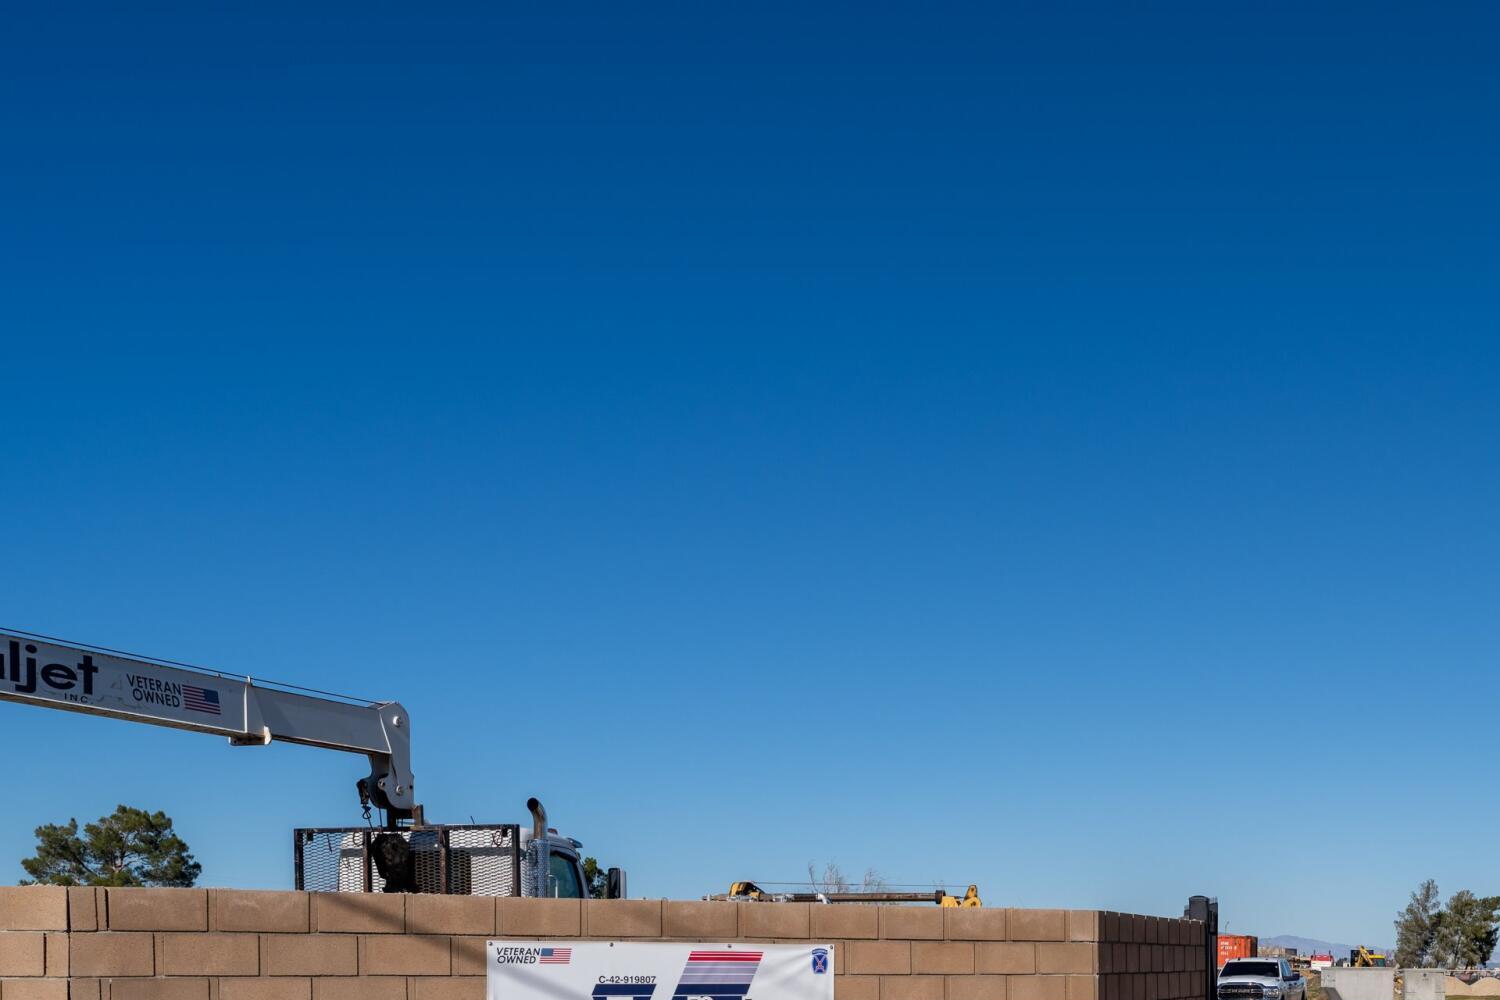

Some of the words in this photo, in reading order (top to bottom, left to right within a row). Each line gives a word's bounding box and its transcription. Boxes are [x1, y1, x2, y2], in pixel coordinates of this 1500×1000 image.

[0, 640, 98, 694] ljet
[126, 673, 182, 696] VETERAN
[132, 687, 180, 708] OWNED
[496, 947, 540, 956] VETERAN
[497, 956, 536, 964] OWNED
[598, 975, 657, 984] C-42-919807
